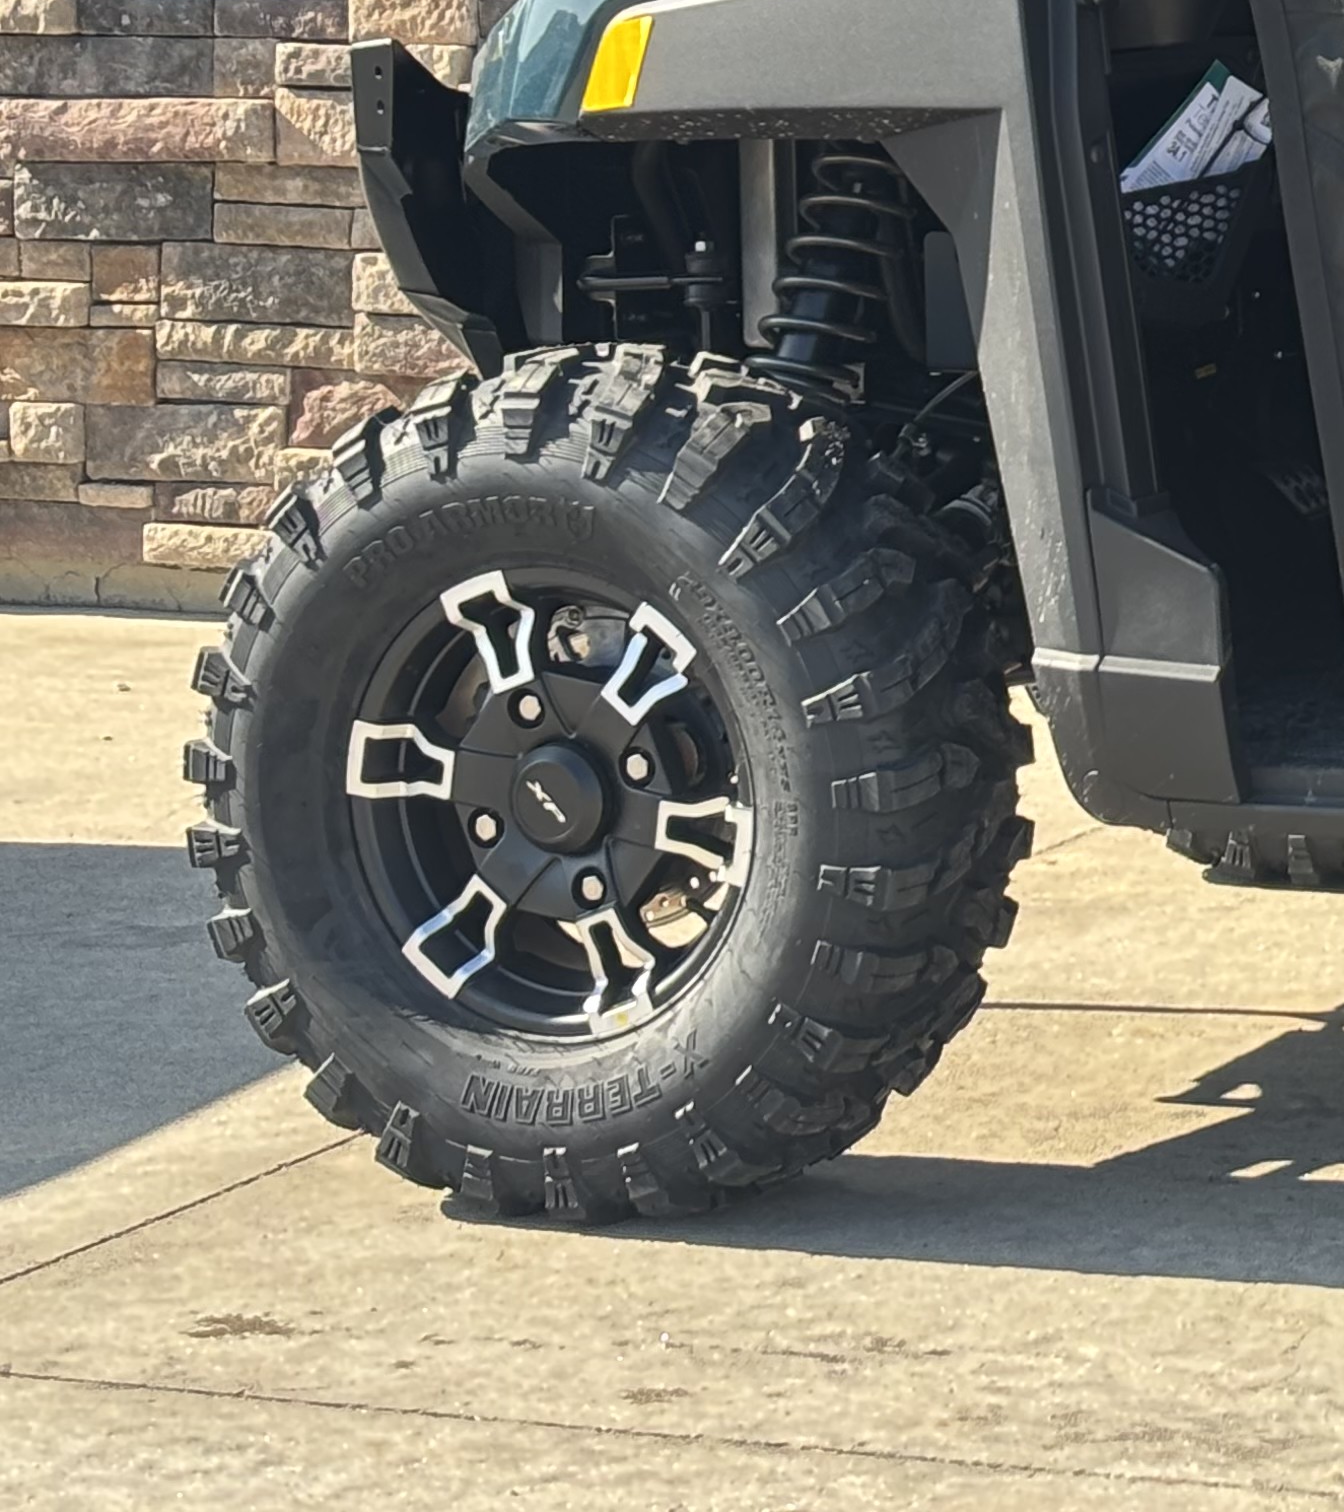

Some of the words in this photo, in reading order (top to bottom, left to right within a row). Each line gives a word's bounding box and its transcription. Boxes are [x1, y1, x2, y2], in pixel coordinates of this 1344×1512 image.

[343, 524, 414, 588] PRO
[417, 494, 560, 542] ARMOR
[526, 780, 567, 823] XP
[460, 1028, 710, 1126] X-TERRAIN
